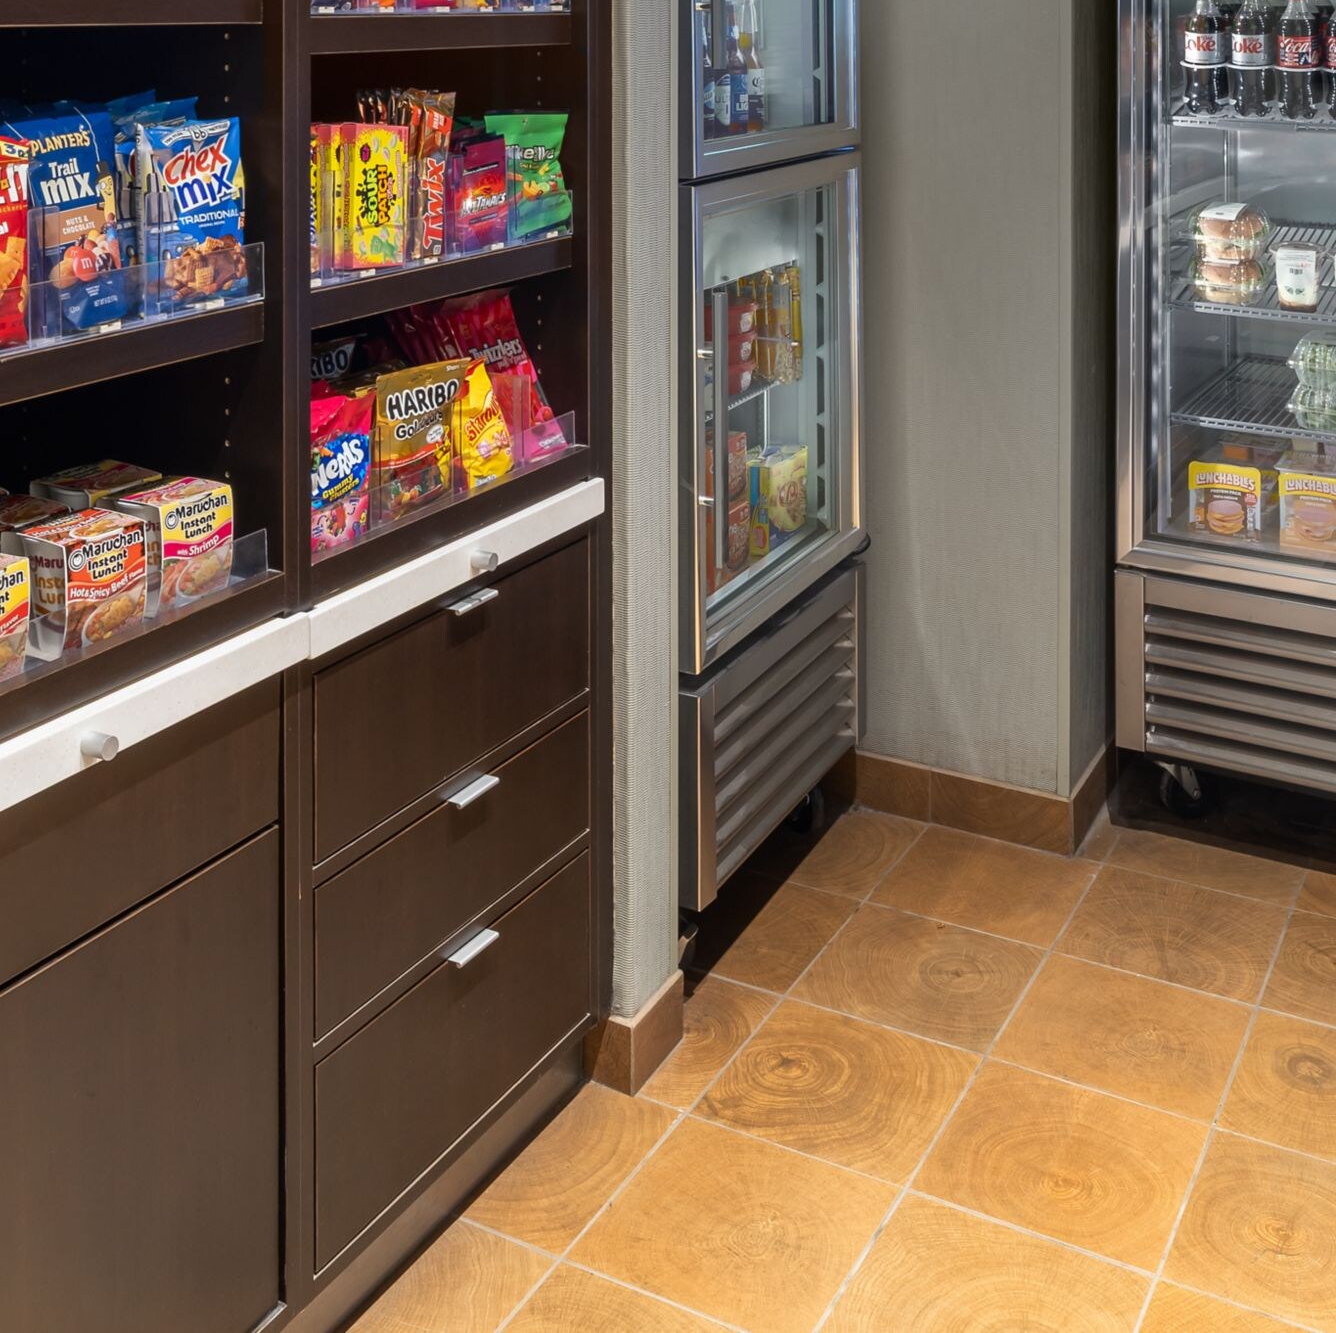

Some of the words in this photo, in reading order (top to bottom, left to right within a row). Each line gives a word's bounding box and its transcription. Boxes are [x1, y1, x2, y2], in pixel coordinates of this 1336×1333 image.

[31, 130, 91, 156] PLANTERS
[49, 158, 78, 178] Trail
[164, 136, 229, 185] Chex
[40, 172, 95, 206] mix
[177, 165, 233, 210] mix
[366, 168, 378, 224] SOUR
[377, 164, 389, 226] PATCH
[62, 221, 95, 235] CHOCOLATE
[66, 216, 82, 226] NUTS
[179, 209, 239, 225] TRADITIONAL
[386, 379, 459, 421] HARIBO
[322, 472, 354, 500] Gummy
[1196, 471, 1255, 491] LUNCHABLES
[175, 493, 228, 520] Maruchan
[180, 512, 216, 531] Instant
[184, 523, 213, 540] Lunch
[81, 530, 142, 559] Maruchan
[177, 548, 188, 556] with
[188, 533, 220, 557] Shrimp
[87, 549, 128, 572] Instant
[92, 562, 125, 580] Lunch
[110, 572, 129, 593] Beef
